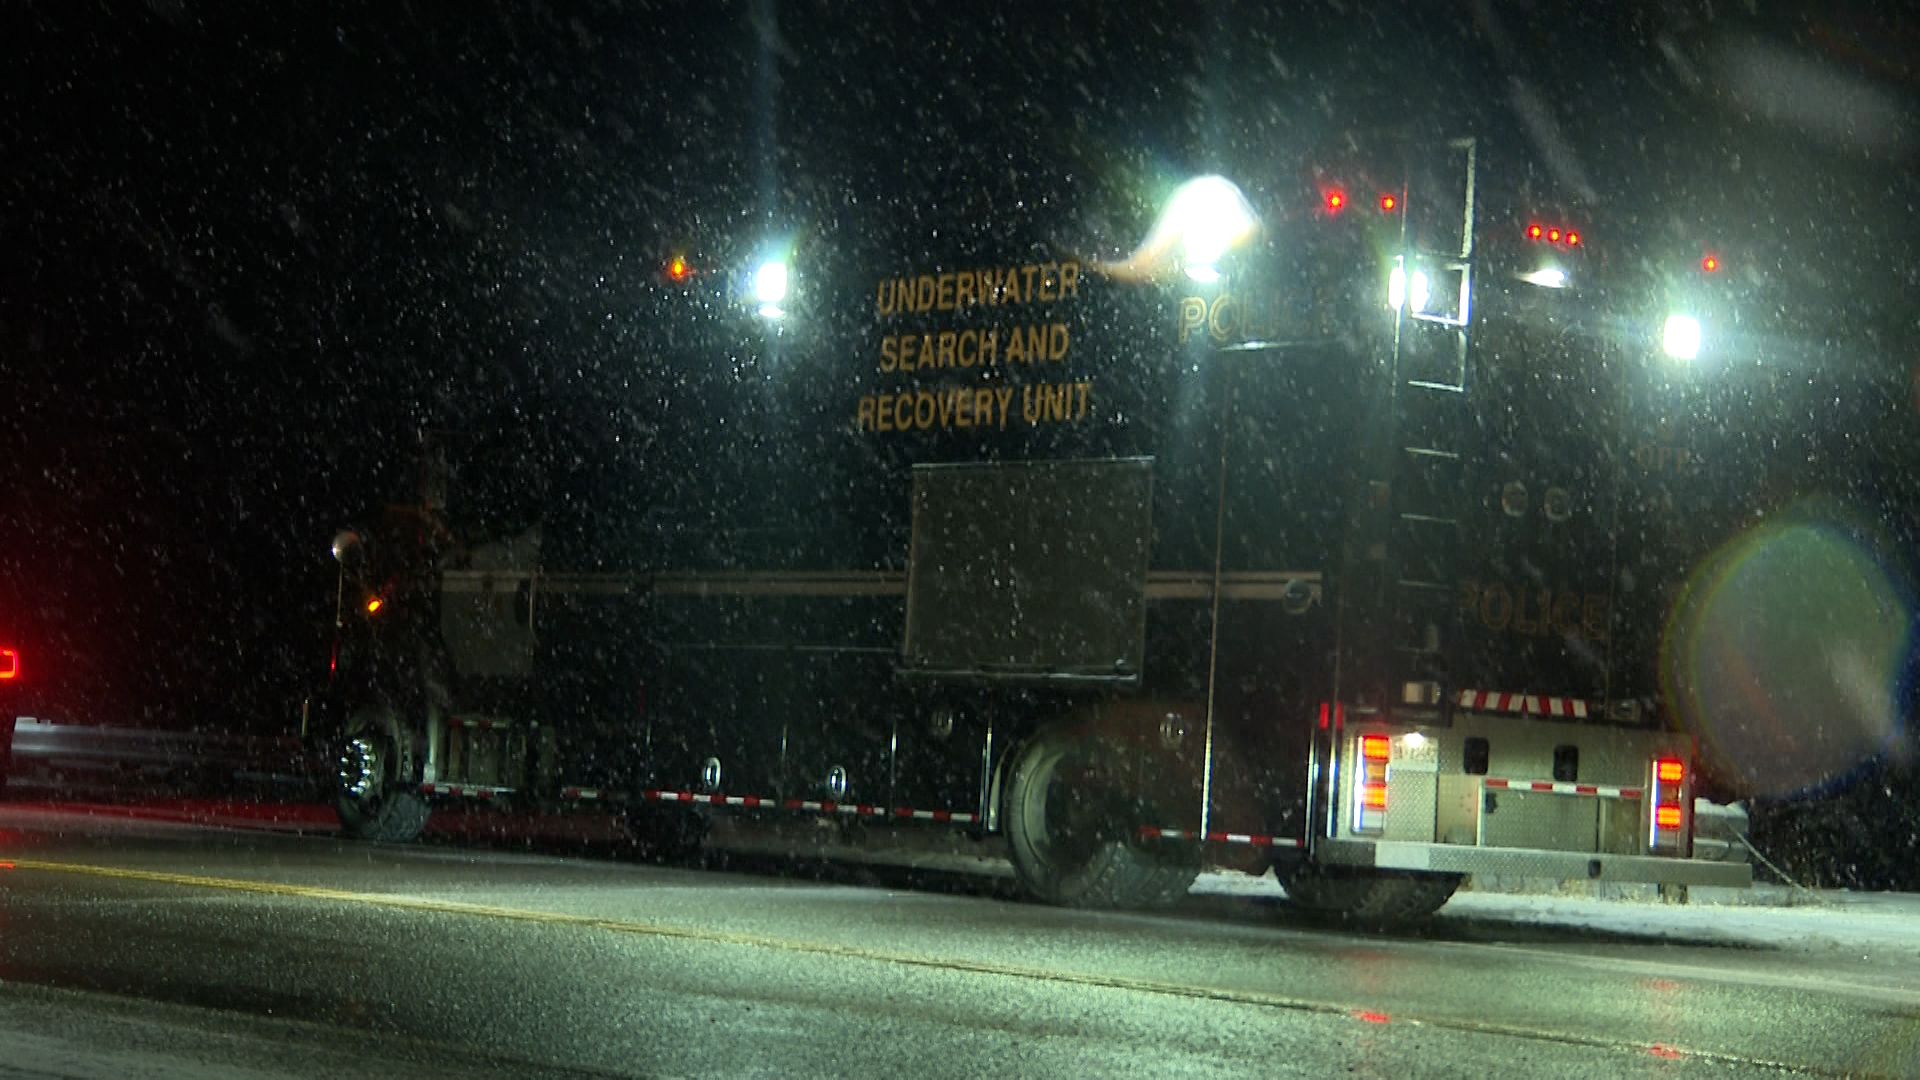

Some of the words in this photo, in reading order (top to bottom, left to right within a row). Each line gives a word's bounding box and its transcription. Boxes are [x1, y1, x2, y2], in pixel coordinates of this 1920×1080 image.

[877, 260, 1080, 316] UNDERWATER
[880, 327, 998, 373] SEARCH
[1006, 322, 1070, 365] AND
[857, 383, 1014, 432] RECOVERY
[1022, 382, 1091, 424] UNIT
